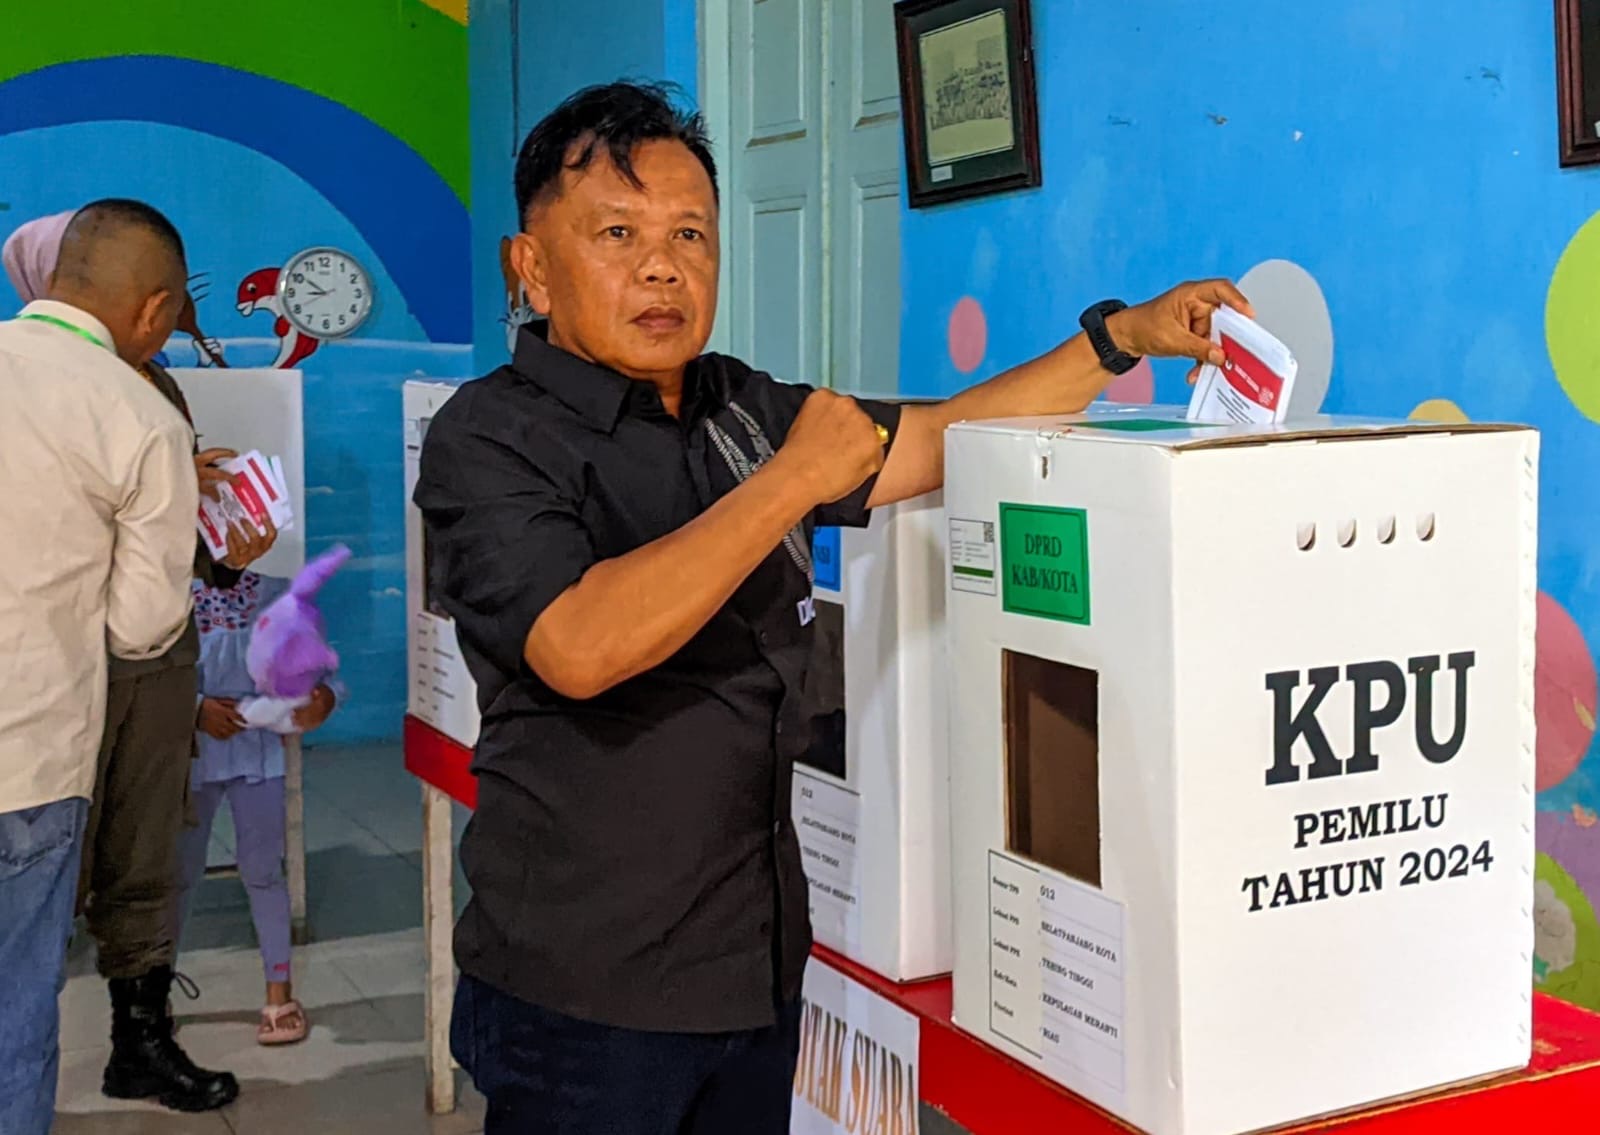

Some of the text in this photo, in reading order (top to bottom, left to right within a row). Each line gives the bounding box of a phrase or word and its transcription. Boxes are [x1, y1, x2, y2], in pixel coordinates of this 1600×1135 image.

[304, 261, 315, 272] 11
[318, 256, 330, 267] 12
[339, 262, 345, 273] 1
[292, 273, 304, 284] 10
[350, 273, 357, 284] 2
[288, 287, 296, 298] 9
[355, 288, 362, 299] 3
[293, 304, 302, 314] 8
[350, 304, 357, 314] 4
[306, 314, 313, 325] 7
[322, 319, 330, 329] 6
[339, 314, 345, 325] 5
[1024, 533, 1062, 558] DPRD
[1012, 563, 1078, 594] KAB/KOTA
[1265, 650, 1476, 786] KPU
[1294, 793, 1448, 849] PEMILU
[1241, 840, 1494, 913] TAHUN 2024
[1040, 885, 1055, 900] 012
